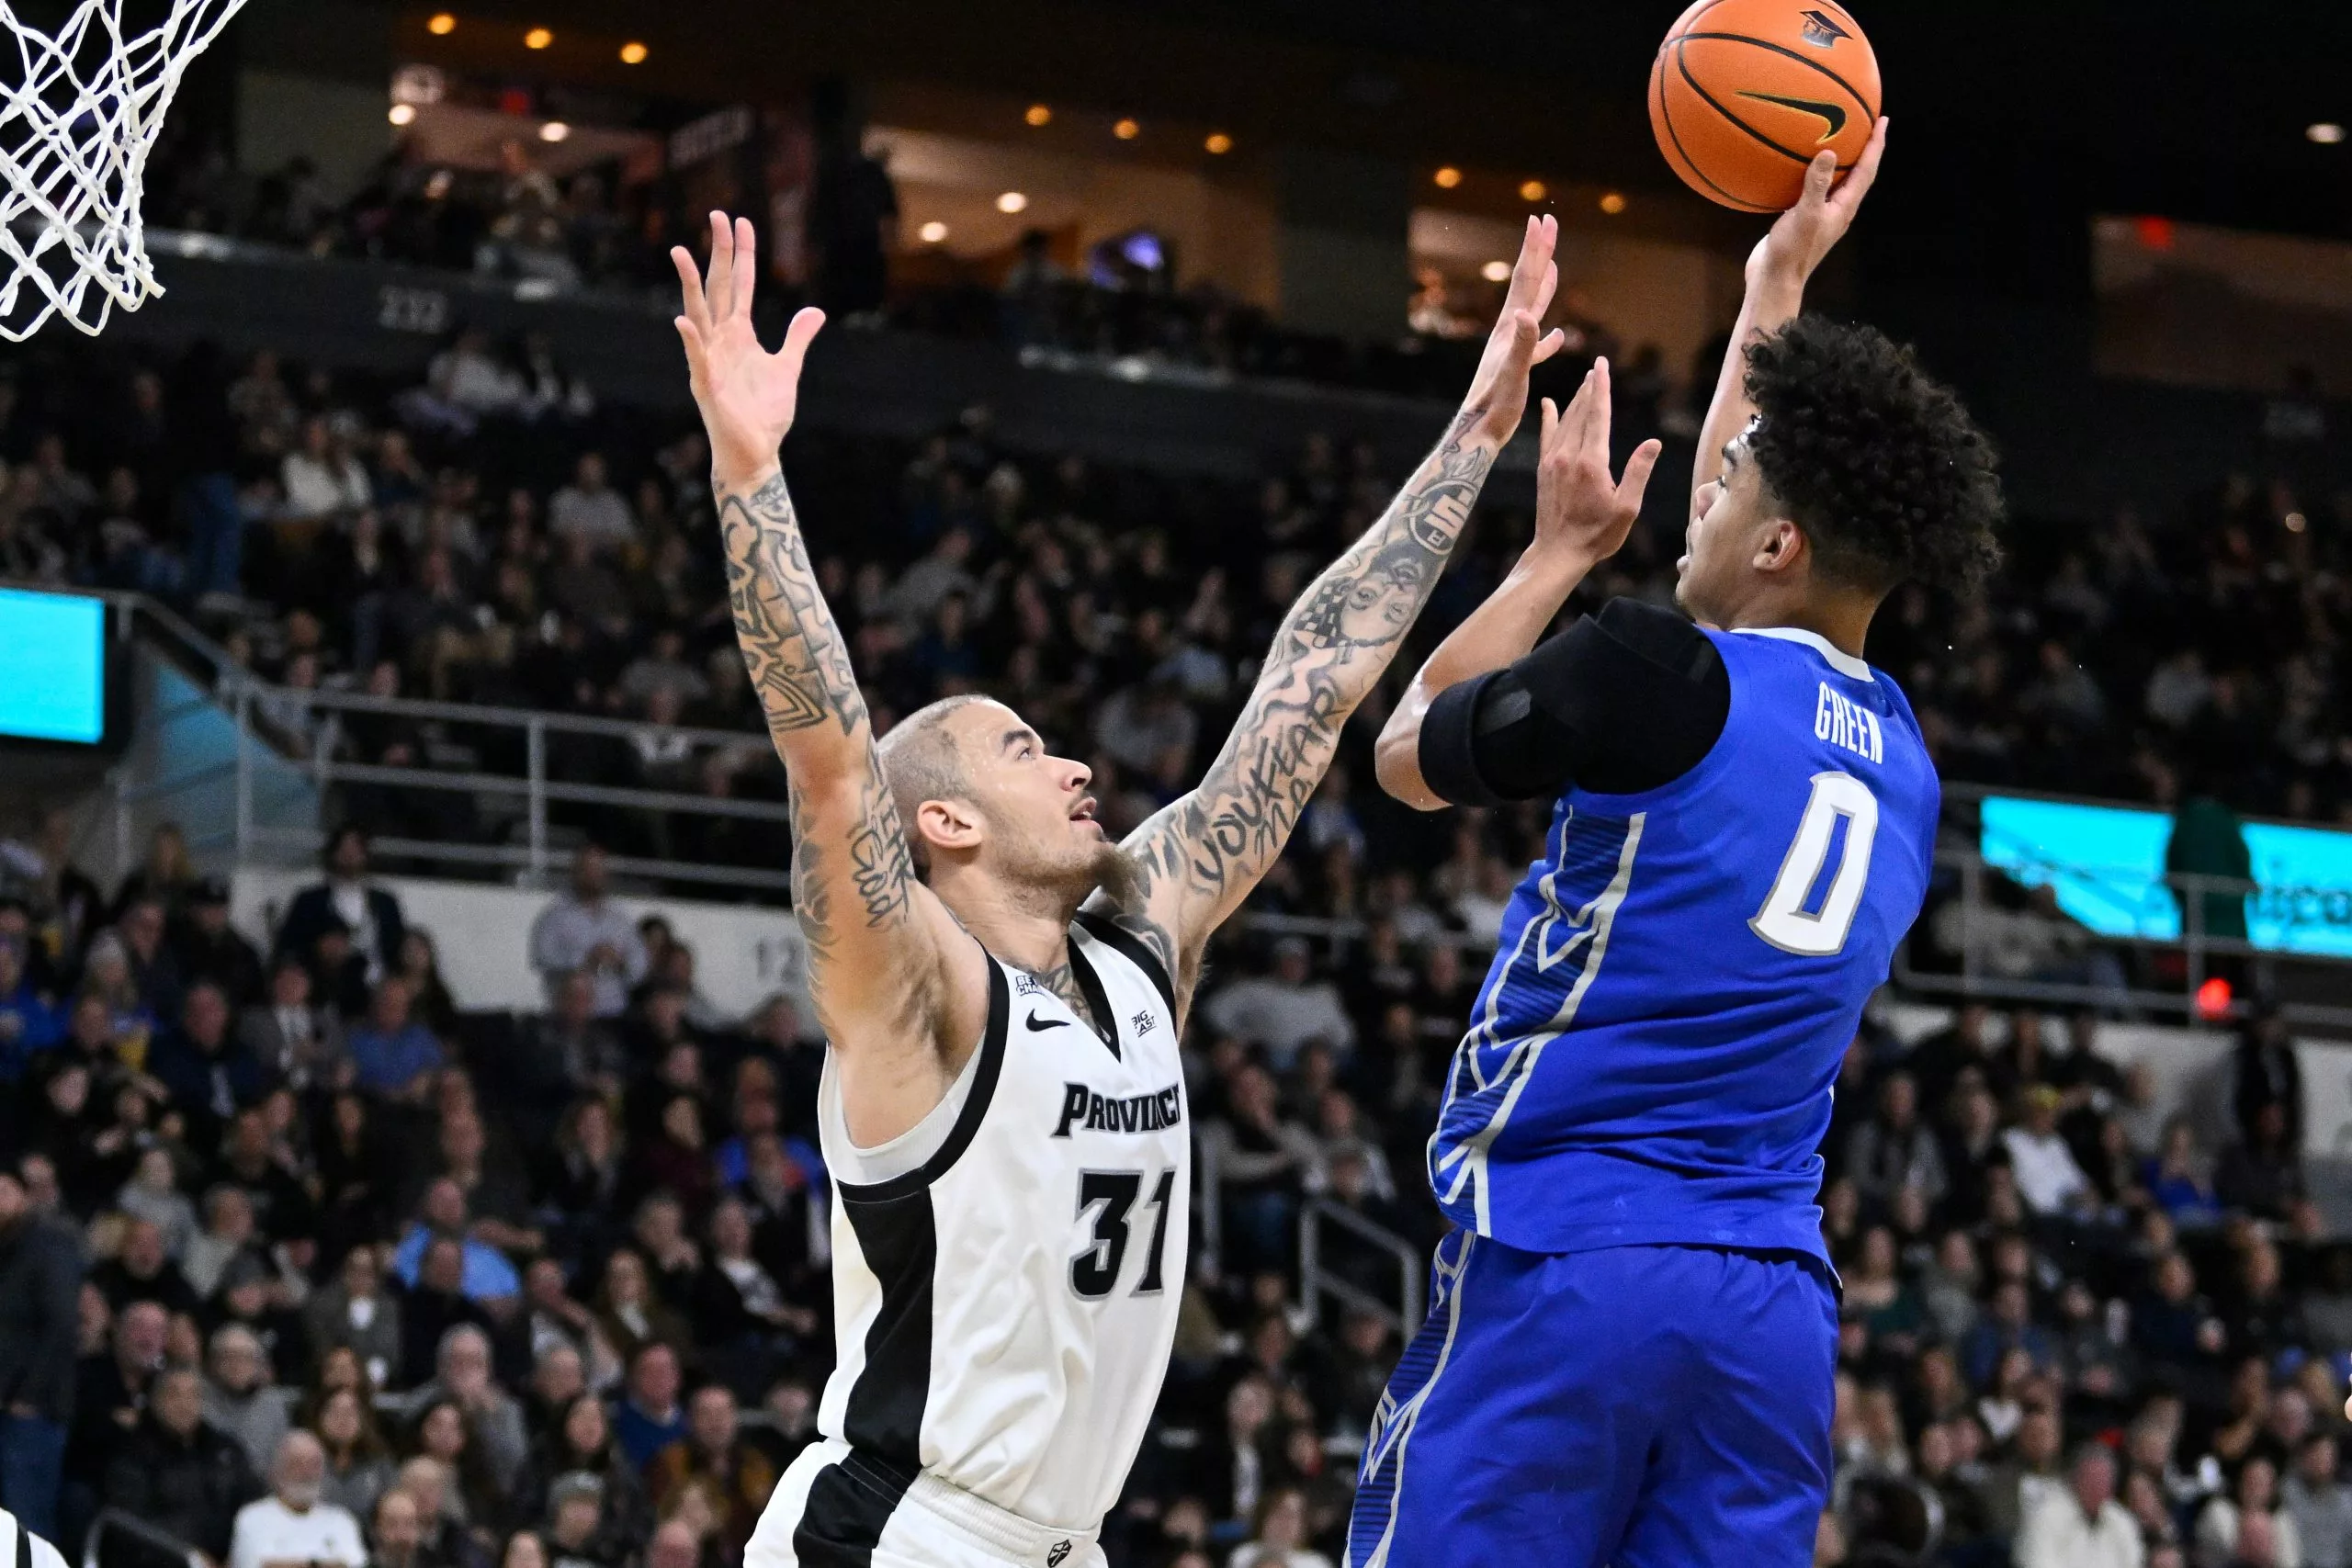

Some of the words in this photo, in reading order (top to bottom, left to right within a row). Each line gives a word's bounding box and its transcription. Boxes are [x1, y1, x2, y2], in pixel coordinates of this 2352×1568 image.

[1814, 681, 1883, 764] GREEN
[1747, 771, 1878, 956] 0
[1067, 1167, 1178, 1303] 31
